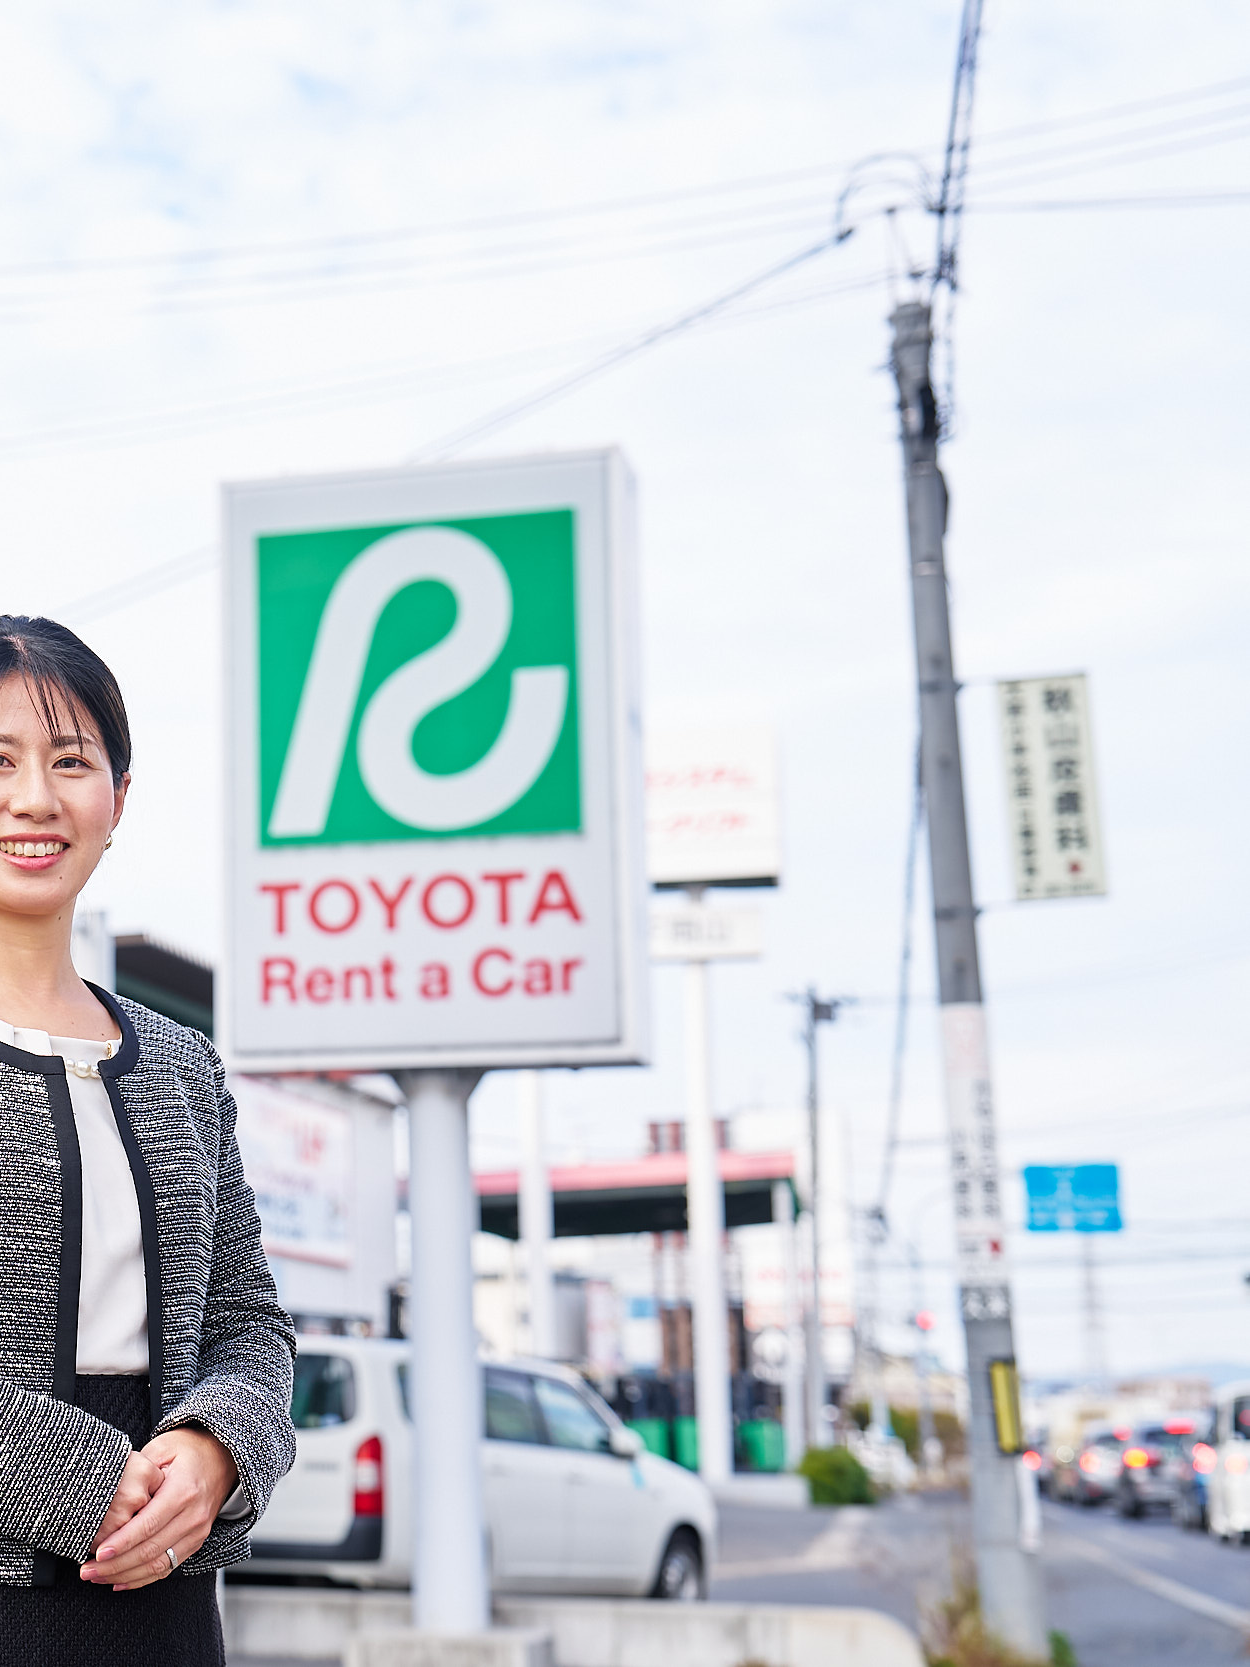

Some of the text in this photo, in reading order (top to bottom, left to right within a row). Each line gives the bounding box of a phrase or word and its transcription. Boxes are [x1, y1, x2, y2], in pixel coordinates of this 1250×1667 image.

[260, 870, 583, 935] TOYOTA
[261, 945, 583, 1004] Rent a Car
